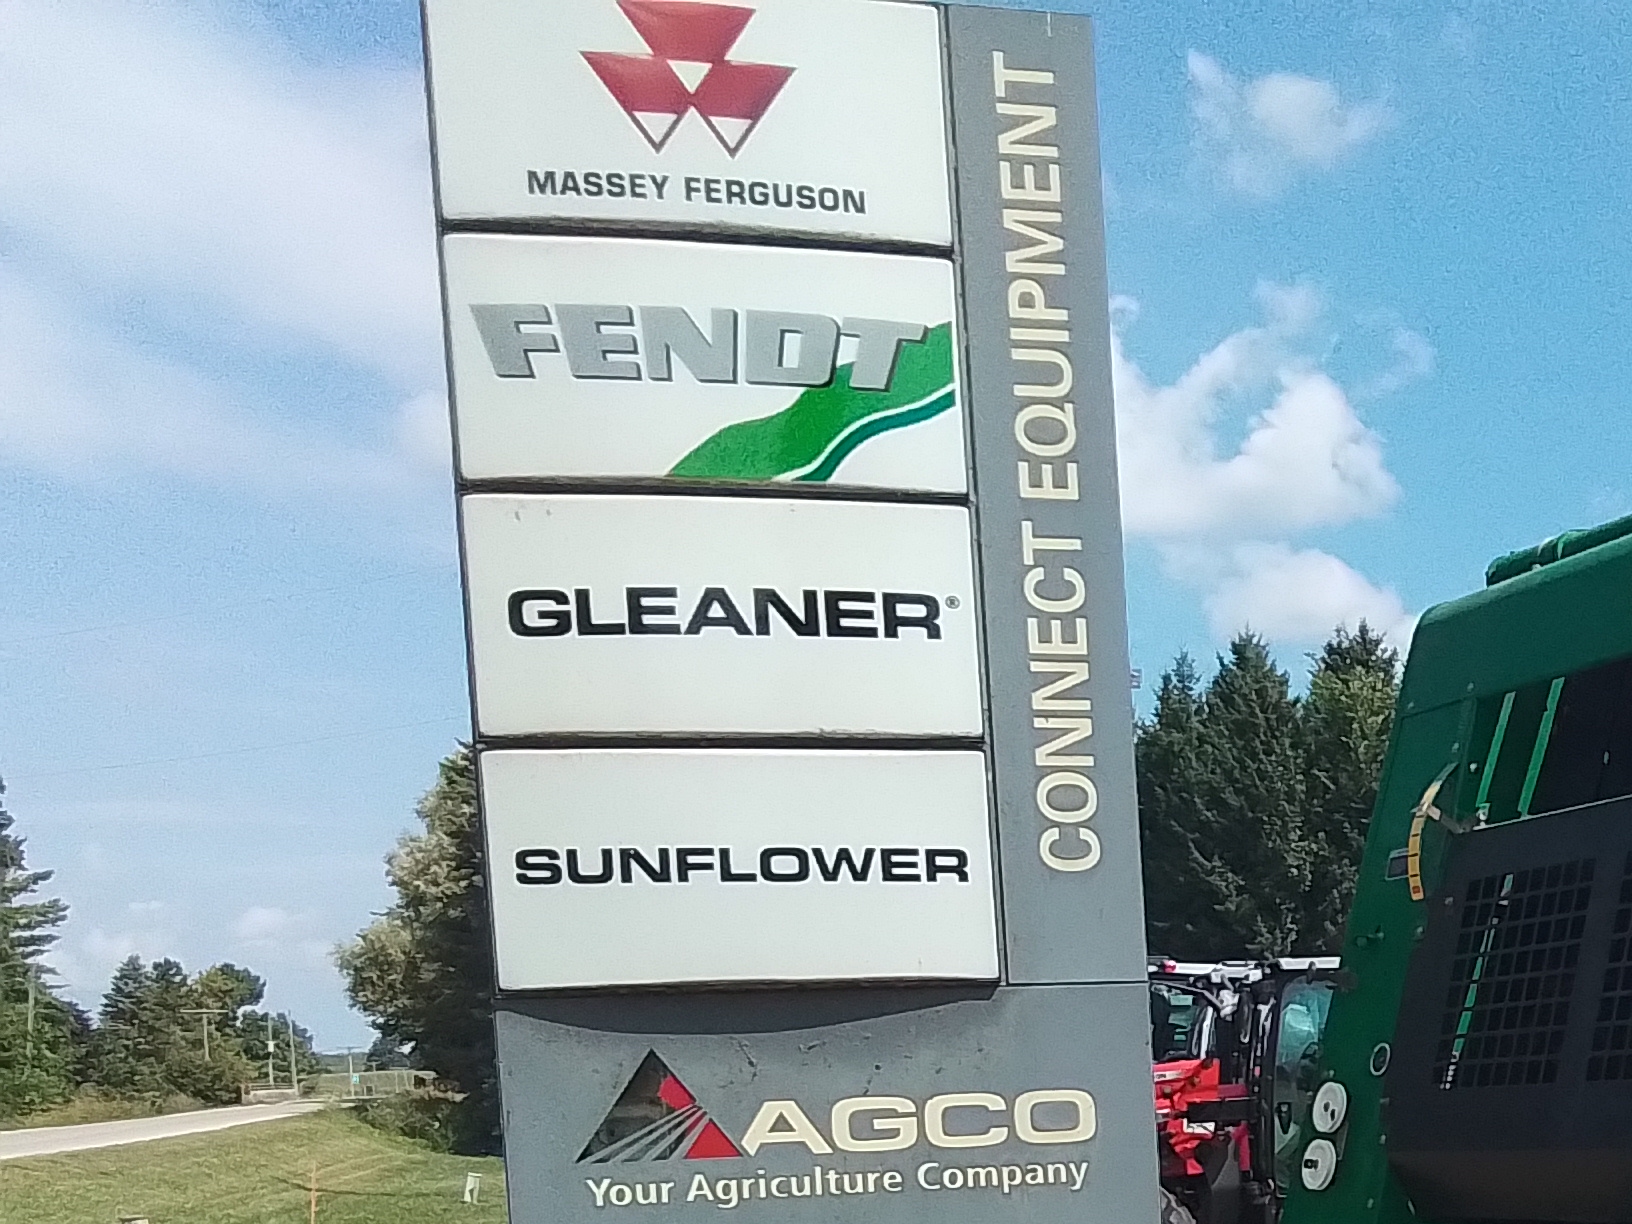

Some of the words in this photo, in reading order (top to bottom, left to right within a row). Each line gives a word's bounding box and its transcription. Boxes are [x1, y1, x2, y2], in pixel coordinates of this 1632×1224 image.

[526, 168, 670, 201] MASSEY
[683, 177, 867, 215] FERGUSON
[991, 50, 1083, 502] EQUIPMENT
[467, 302, 931, 392] FENDT
[1021, 519, 1102, 873] CONNECT
[514, 847, 970, 884] SUNFLOWER
[740, 1088, 1097, 1155] AGCO
[587, 1177, 675, 1208] Your
[685, 1165, 903, 1206] Agriculture
[916, 1158, 1089, 1196] Company
